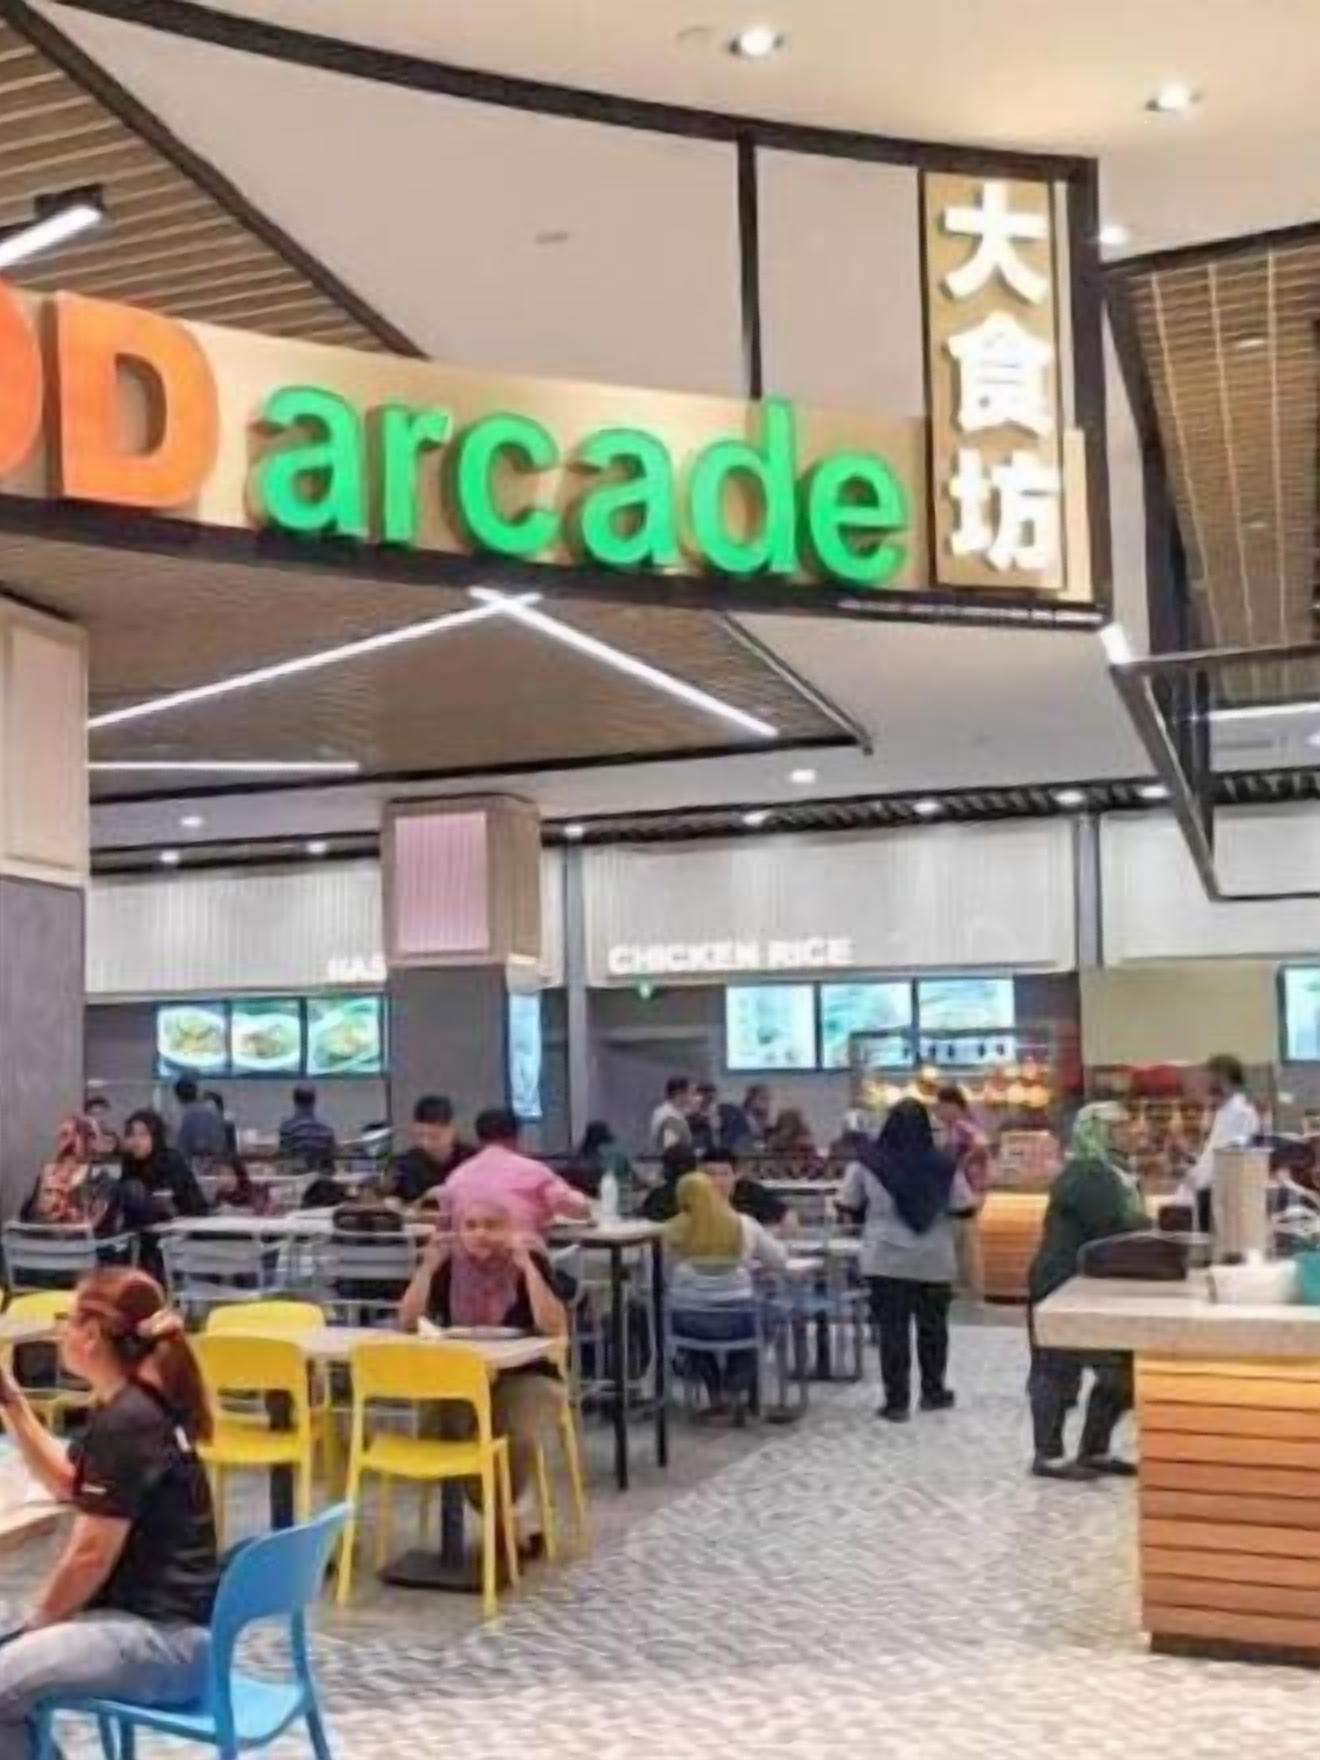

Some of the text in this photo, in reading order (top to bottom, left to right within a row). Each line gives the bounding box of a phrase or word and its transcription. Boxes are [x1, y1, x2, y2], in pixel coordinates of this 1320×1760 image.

[942, 182, 1062, 571] 大食坊
[252, 385, 909, 585] arcade
[608, 937, 854, 975] CHICKEN RICE
